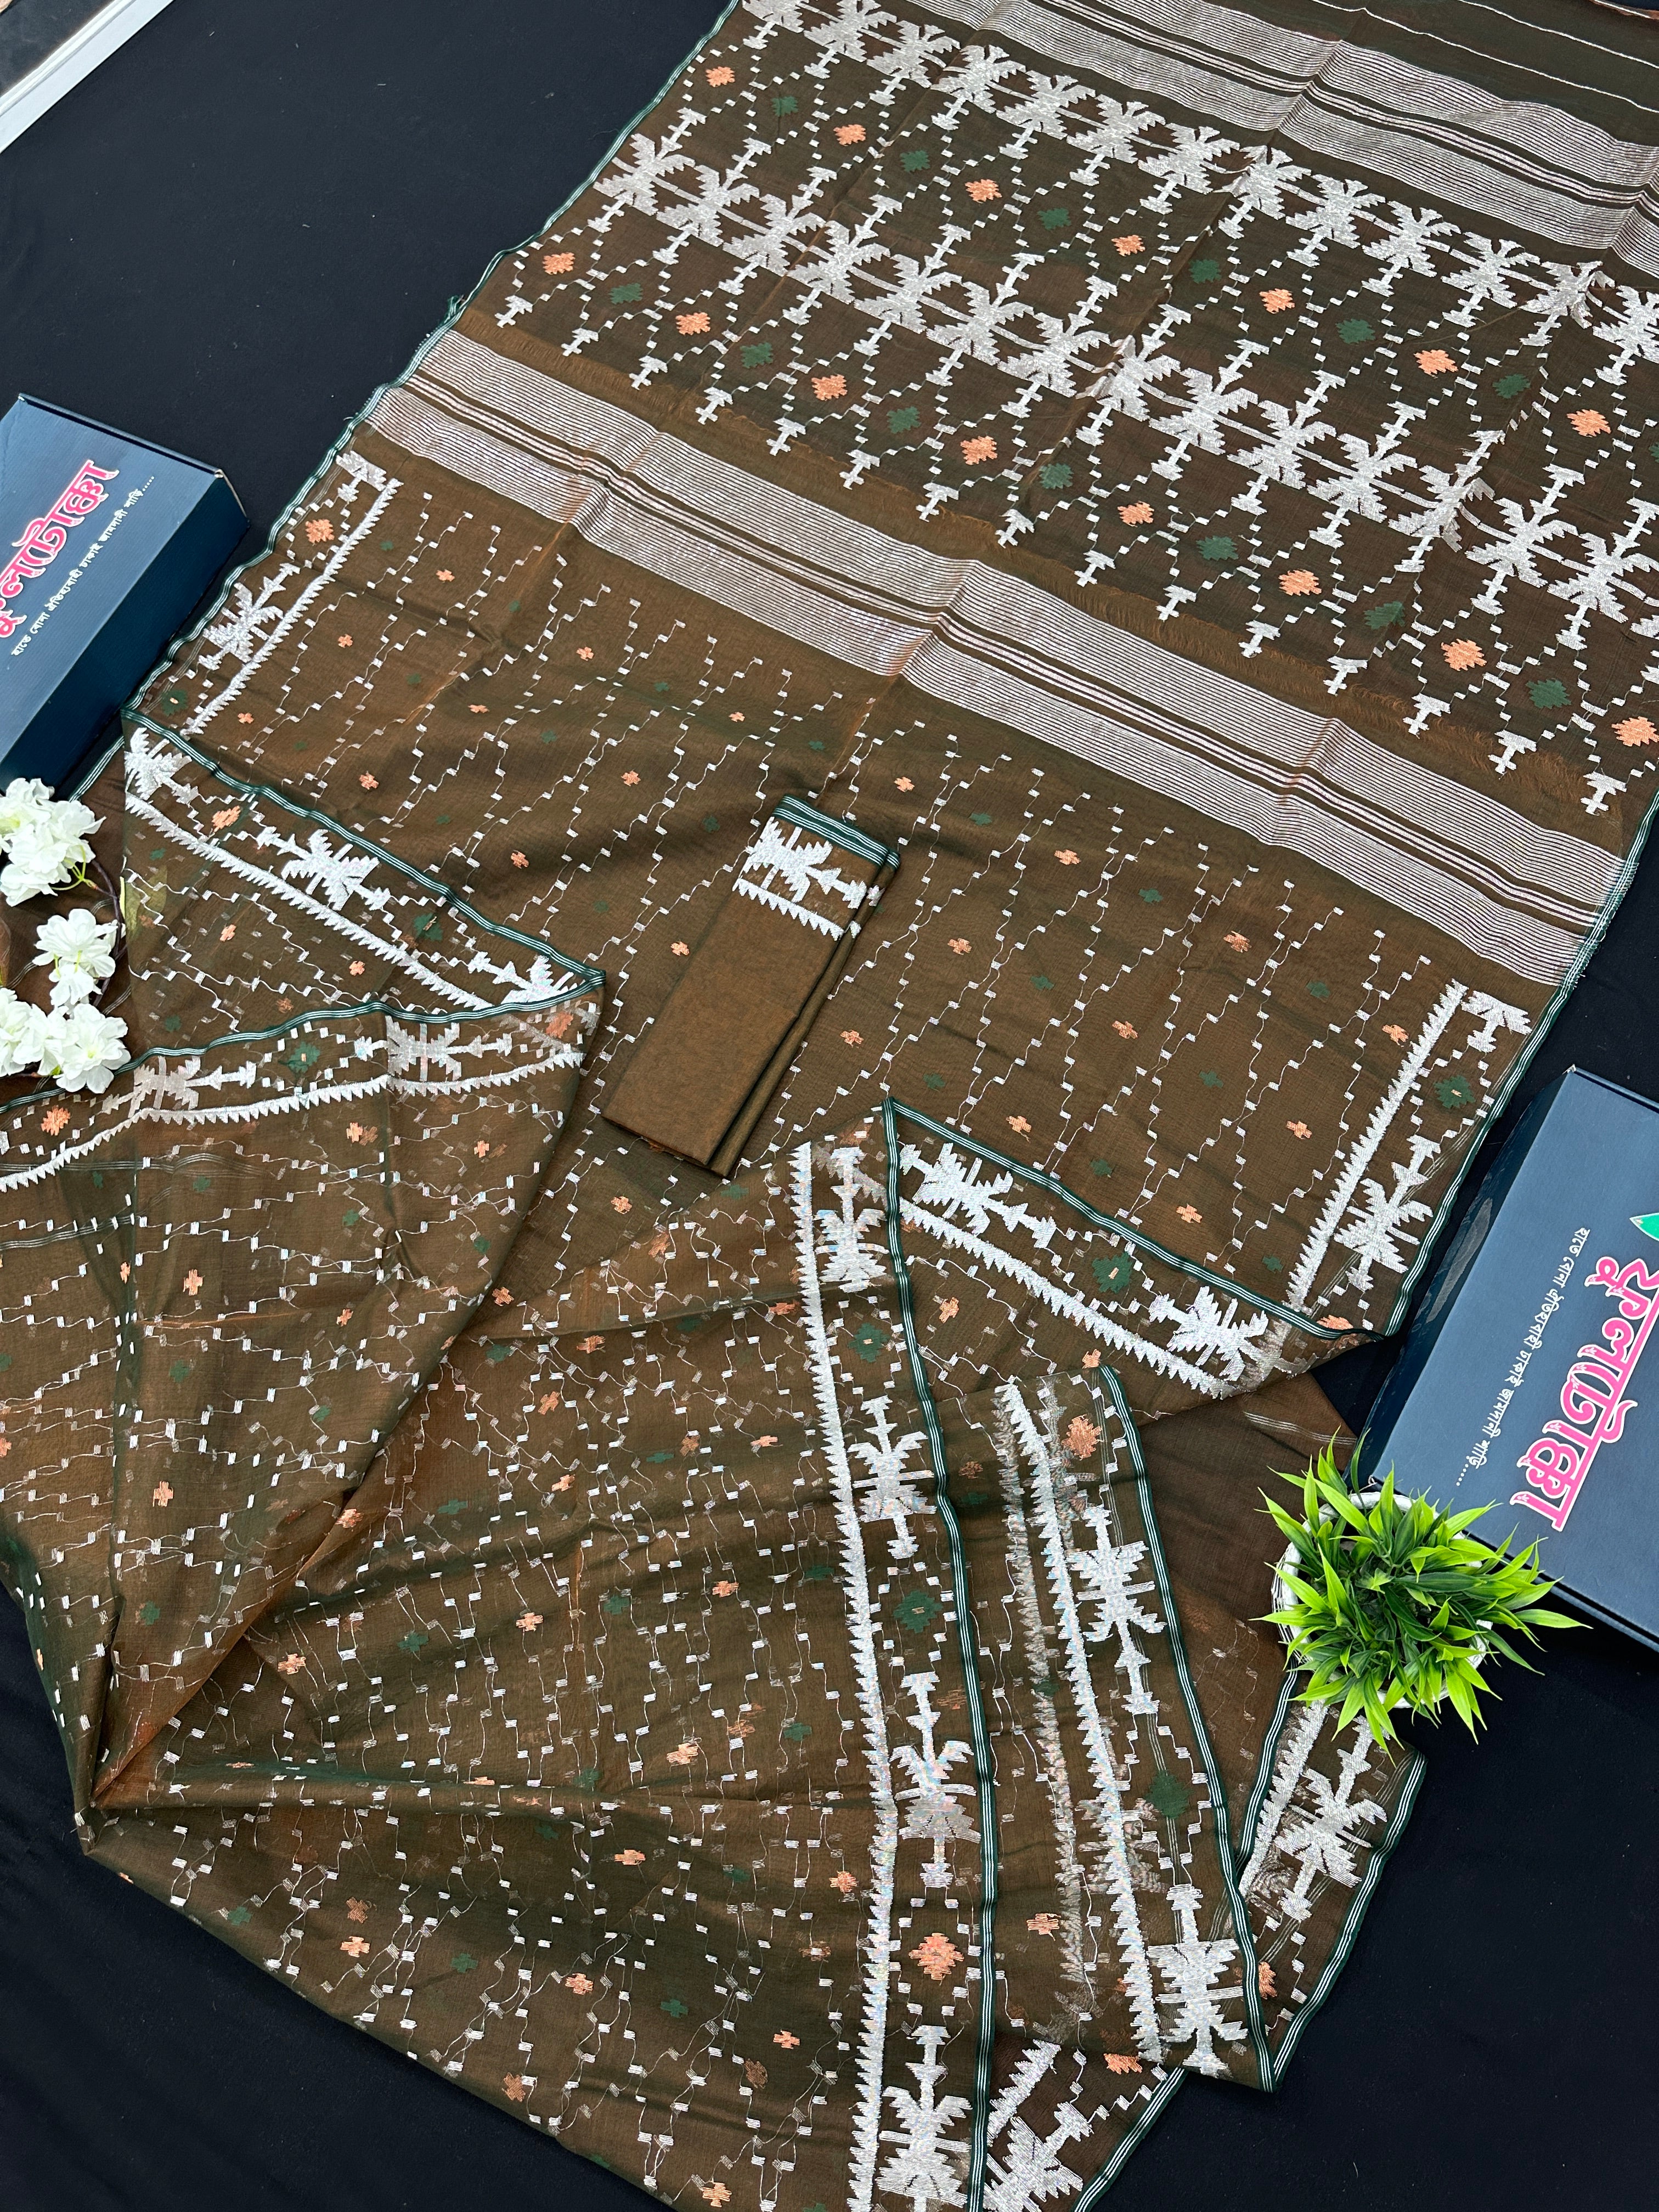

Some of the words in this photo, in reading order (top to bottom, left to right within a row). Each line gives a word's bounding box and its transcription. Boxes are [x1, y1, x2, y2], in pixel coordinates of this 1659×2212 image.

[11, 634, 32, 656] হাতে
[30, 612, 50, 634] বোনা
[78, 543, 104, 568] ঢাকাই
[98, 509, 128, 541] জামদানী
[1569, 1228, 1590, 1257] হাতে
[1552, 1256, 1575, 1289] বোনা
[1523, 1288, 1565, 1350] ঐতিহ্যবাহী
[1504, 1350, 1532, 1387] ঢাকাই
[1482, 1389, 1515, 1438] জামদানী
